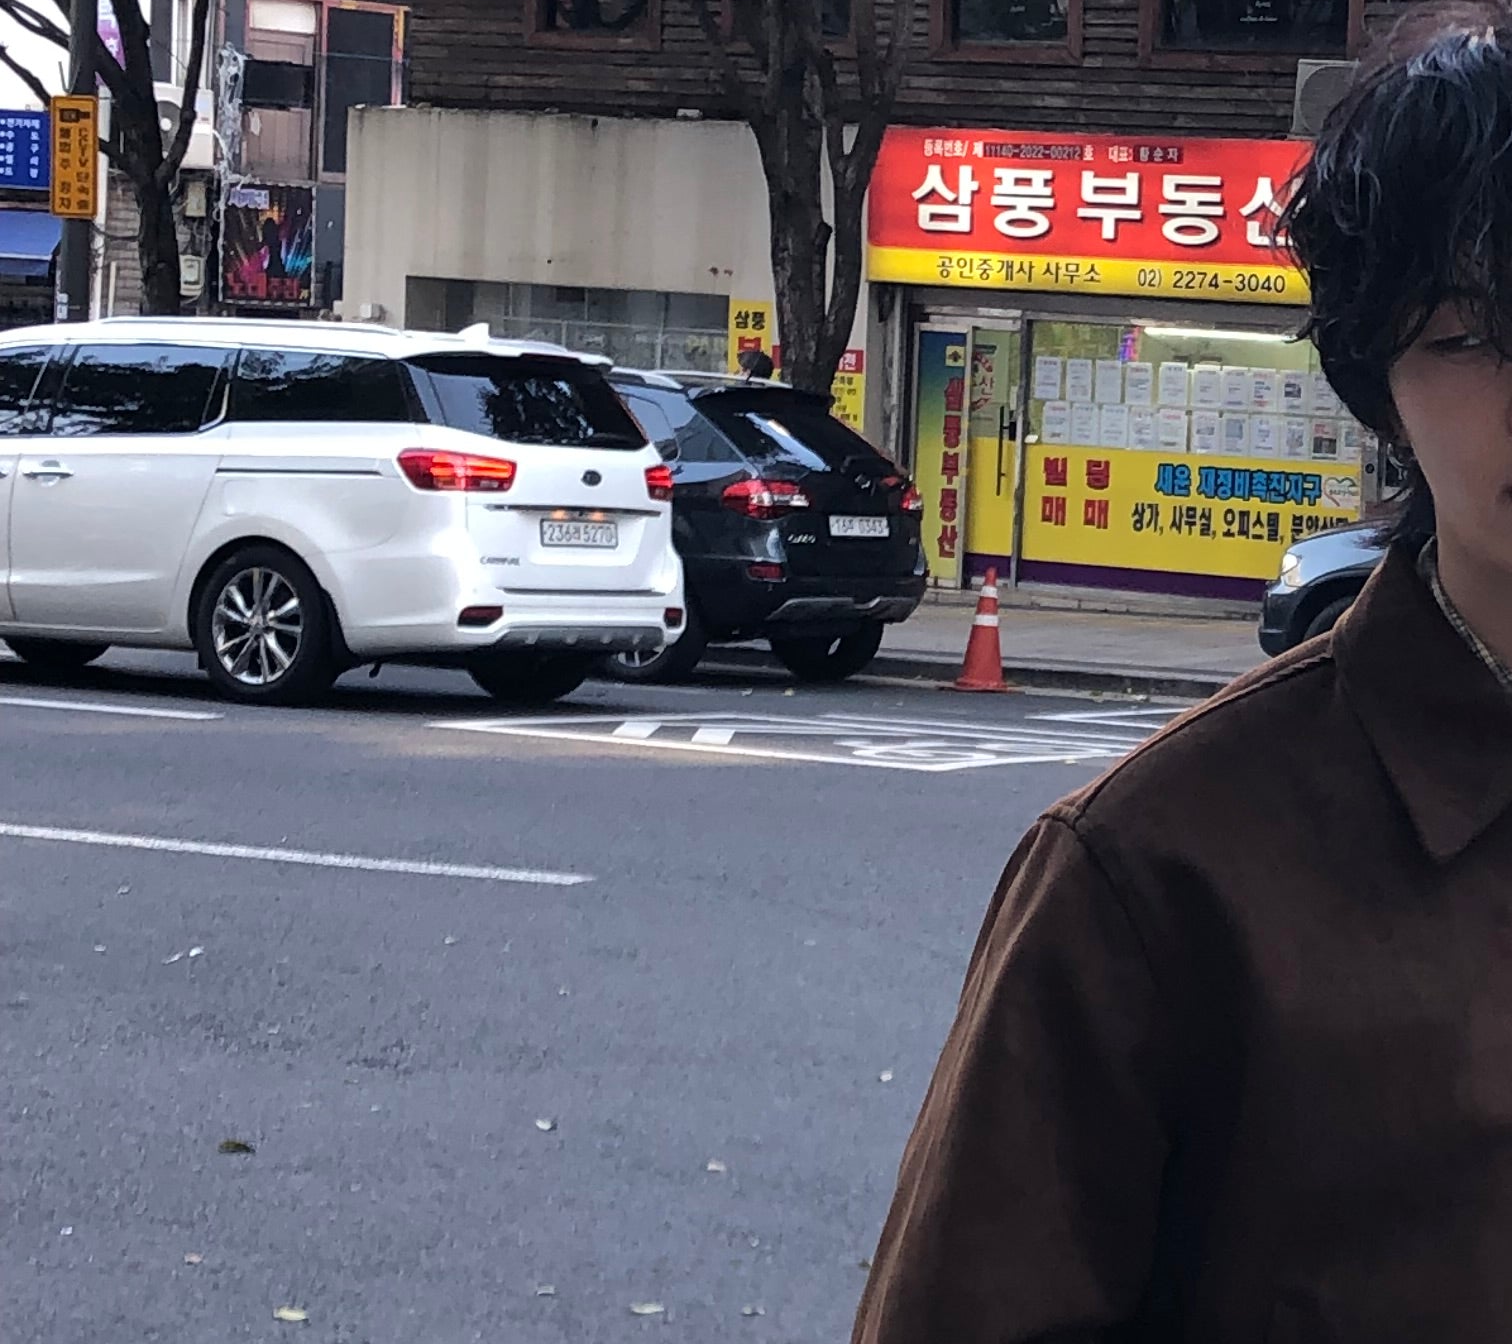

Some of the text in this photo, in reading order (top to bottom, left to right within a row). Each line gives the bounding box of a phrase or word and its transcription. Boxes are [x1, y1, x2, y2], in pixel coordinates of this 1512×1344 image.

[936, 255, 1287, 294] 공인중개사 사무소 02) 2274-3040
[734, 310, 766, 330] 삼풍
[1170, 505, 1217, 540] 사무실,
